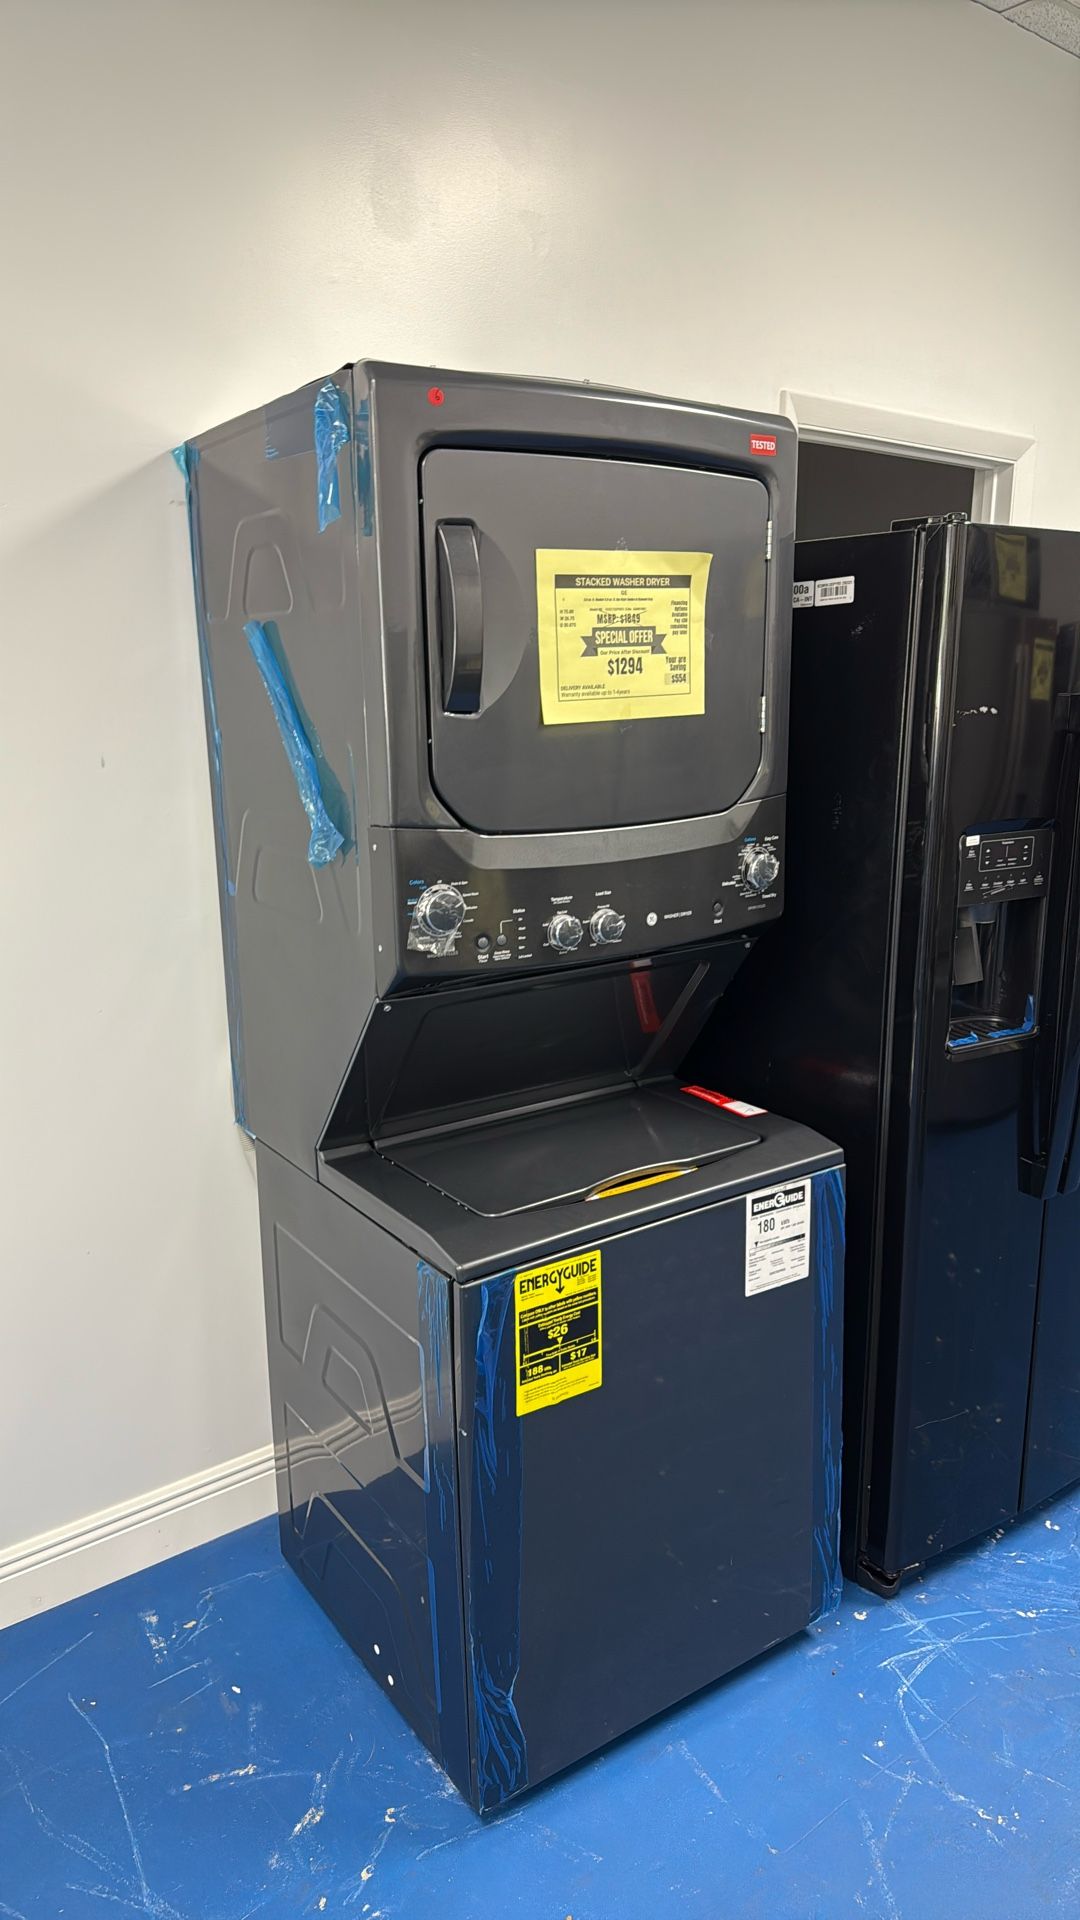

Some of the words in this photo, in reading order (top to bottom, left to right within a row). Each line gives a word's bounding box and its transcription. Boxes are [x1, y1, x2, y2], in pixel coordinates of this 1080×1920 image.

[751, 439, 776, 451] TESTED
[575, 577, 611, 587] STACKED
[612, 577, 645, 586] WASHER
[646, 577, 670, 586] DRYER
[793, 584, 809, 595] 00a
[620, 613, 641, 624] $1849
[595, 631, 628, 645] SPECIAL
[629, 630, 653, 643] OFFER
[608, 657, 643, 676] $1294
[666, 656, 676, 664] Your
[670, 664, 686, 672] Saving
[671, 674, 687, 684] $554
[753, 1191, 804, 1213] ENERGUIDE
[758, 1218, 775, 1234] 180
[520, 1258, 597, 1294] ENERGYGUIDE
[547, 1323, 568, 1340] $26
[570, 1347, 587, 1361] $17
[527, 1364, 543, 1378] 188
